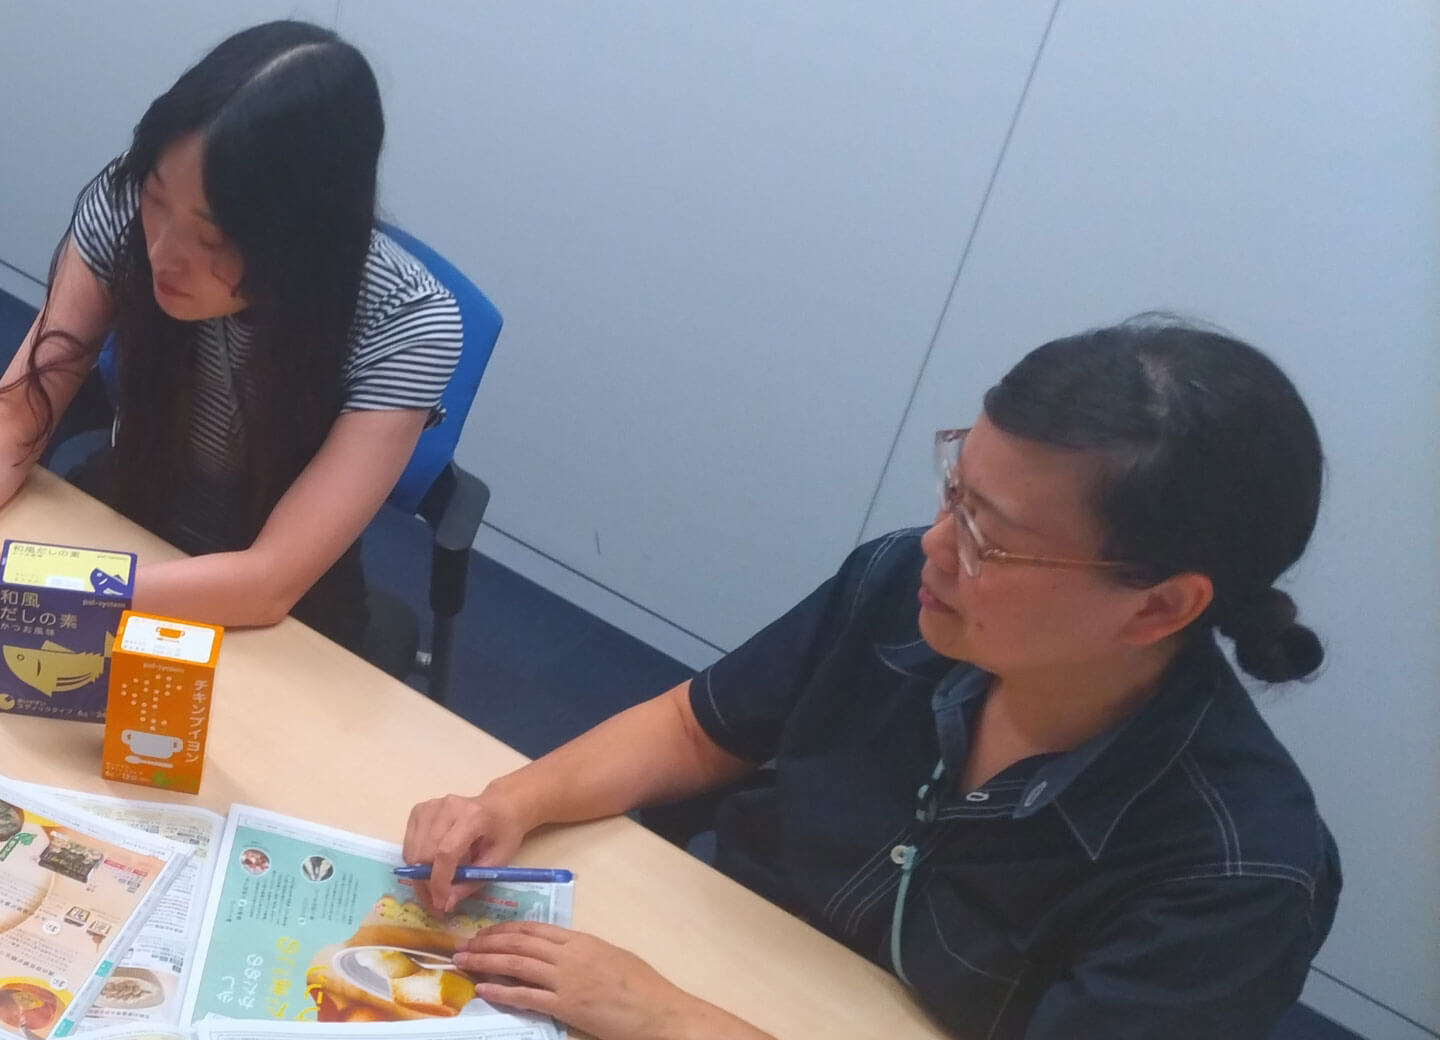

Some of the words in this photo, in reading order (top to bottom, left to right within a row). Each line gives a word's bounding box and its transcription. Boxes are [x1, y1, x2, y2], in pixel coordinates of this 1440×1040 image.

[0, 589, 40, 608] 和風
[0, 606, 78, 630] だしの素
